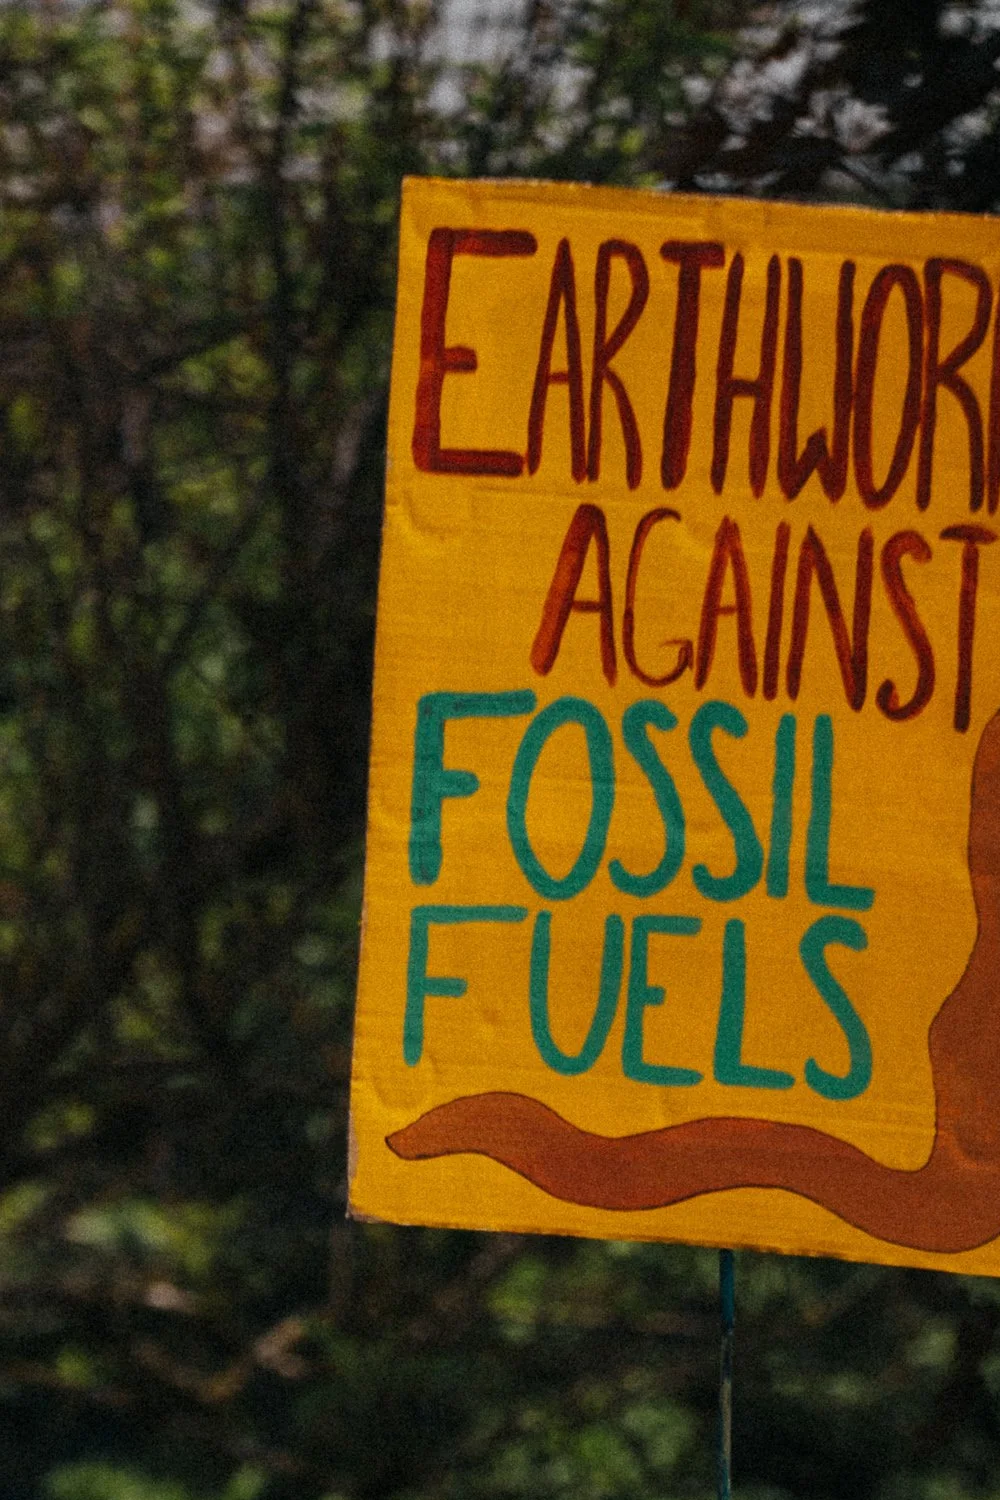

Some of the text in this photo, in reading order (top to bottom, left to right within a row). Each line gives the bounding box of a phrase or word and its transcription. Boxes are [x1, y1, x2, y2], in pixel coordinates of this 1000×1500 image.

[529, 503, 998, 732] AGAINST
[409, 689, 876, 911] FOSSIL
[403, 905, 872, 1100] FUELS
